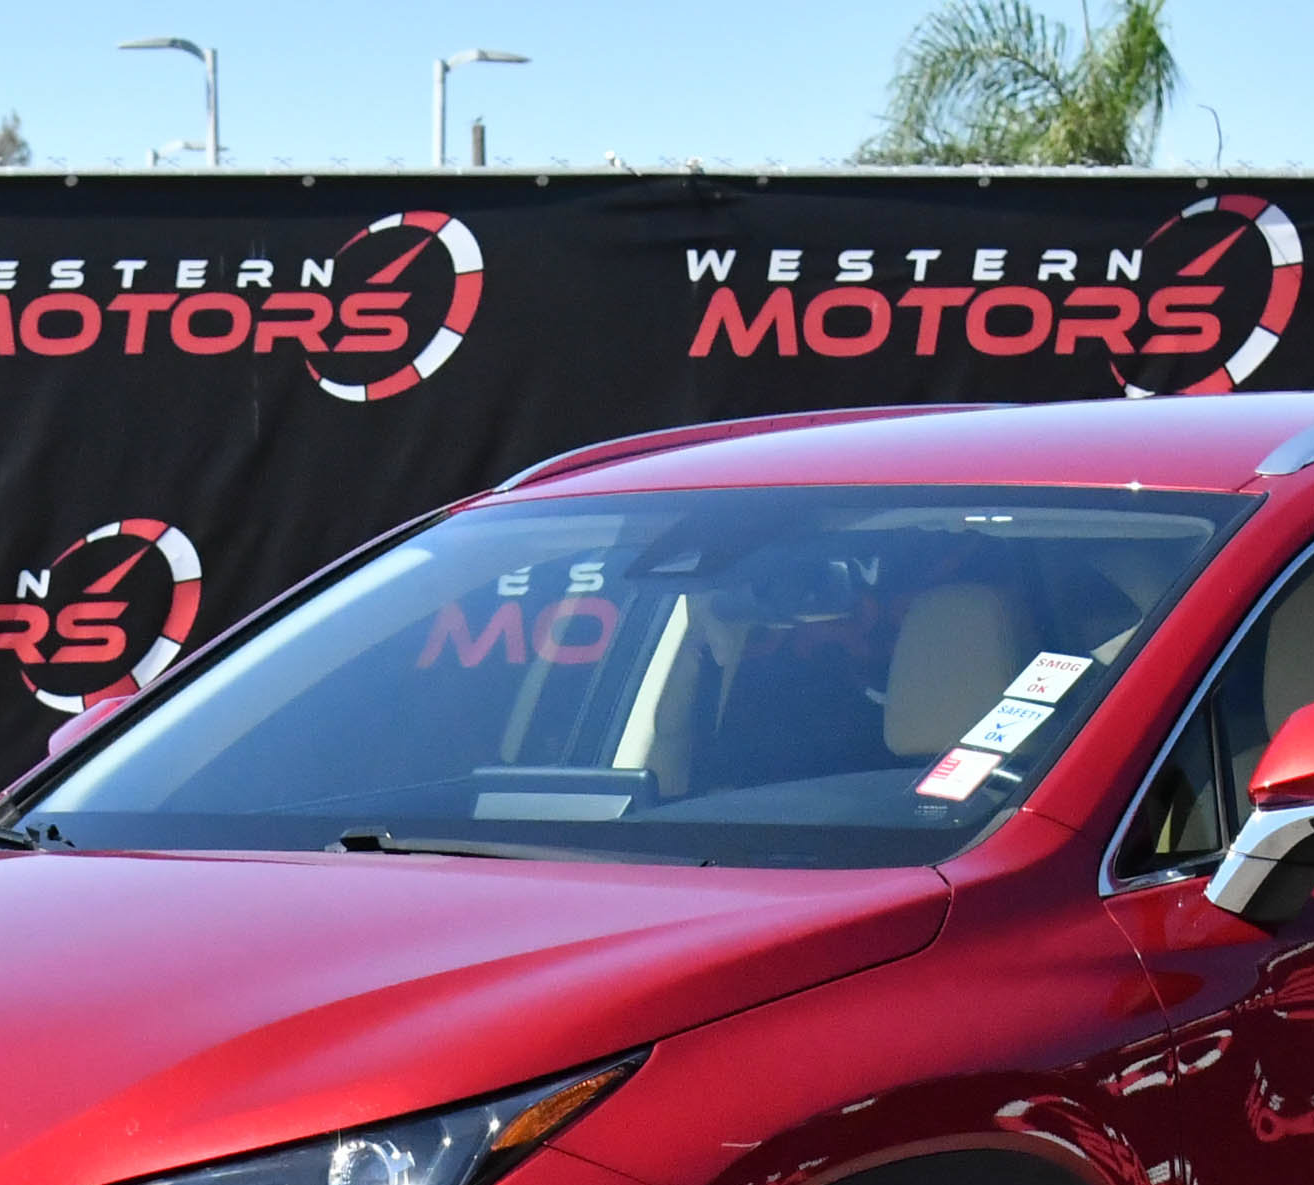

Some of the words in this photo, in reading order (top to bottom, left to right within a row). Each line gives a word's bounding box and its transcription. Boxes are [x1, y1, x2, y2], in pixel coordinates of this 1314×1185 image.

[686, 248, 1143, 282] WESTERN
[688, 285, 1225, 357] MOTORS
[1035, 657, 1082, 673] SMOG
[1026, 683, 1048, 694] OK
[997, 704, 1043, 721] SAFETY
[984, 731, 1006, 743] OK
